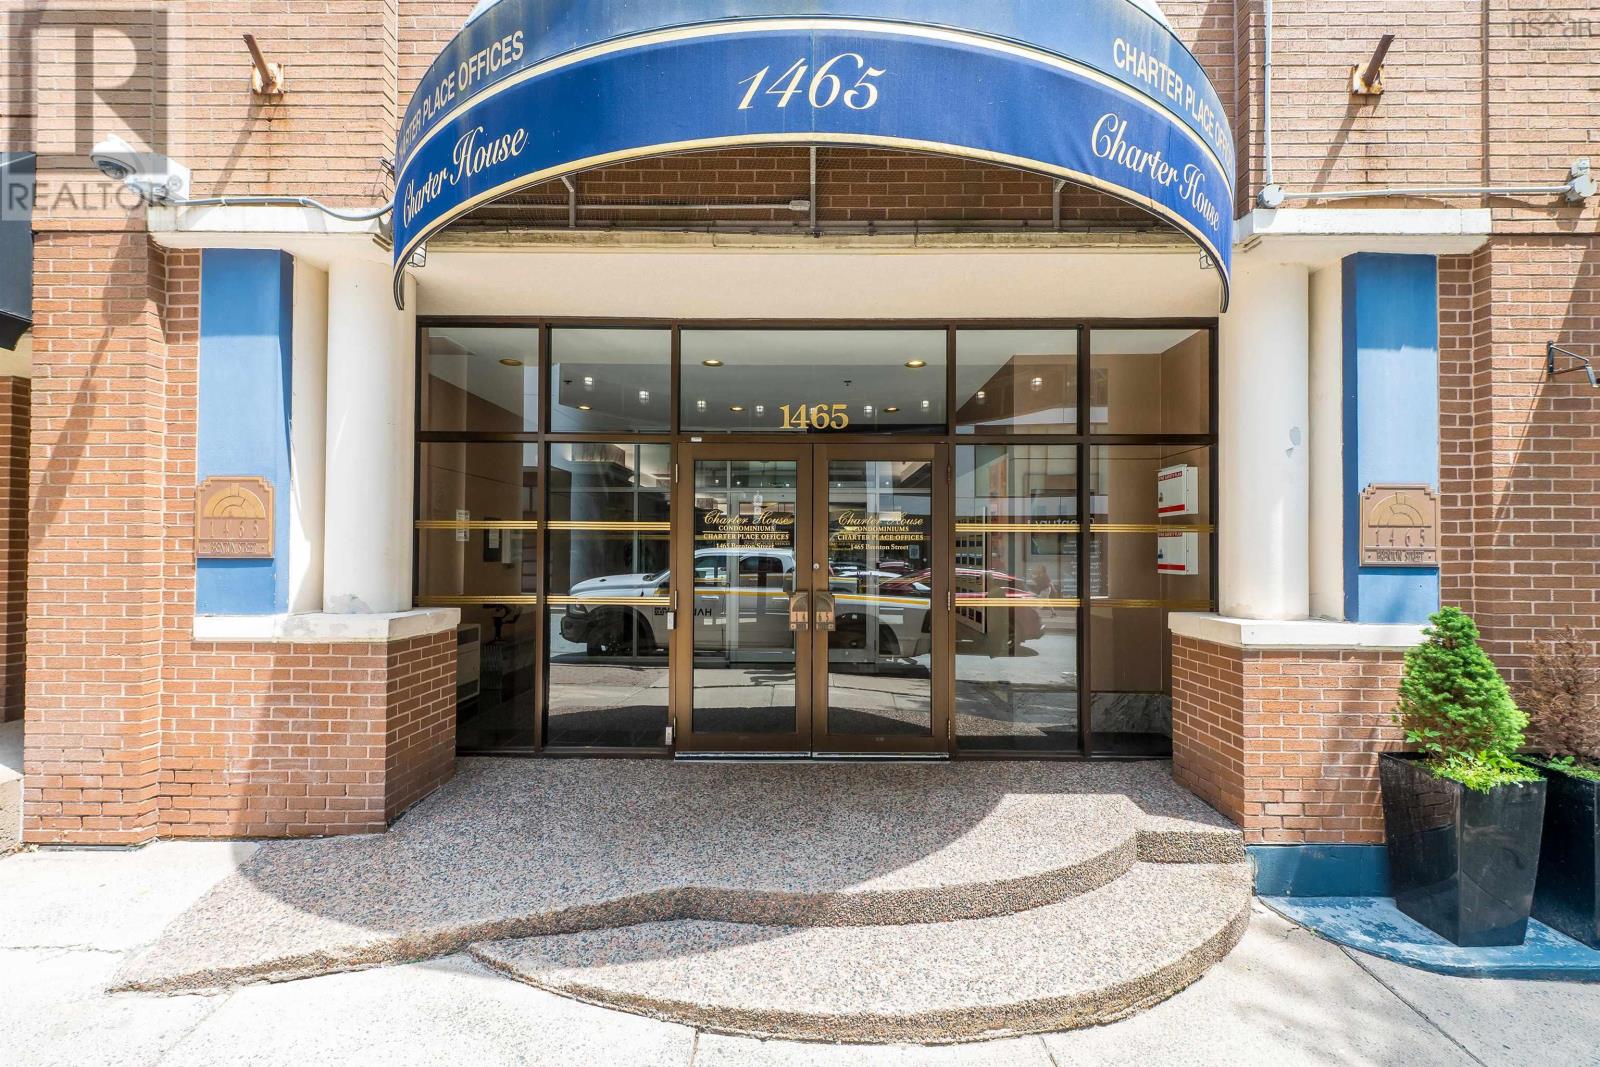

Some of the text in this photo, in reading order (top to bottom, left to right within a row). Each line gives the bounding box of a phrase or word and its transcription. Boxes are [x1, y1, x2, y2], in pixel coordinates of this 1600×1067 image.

[422, 69, 456, 126] PLACE
[458, 30, 524, 92] OFFICES
[737, 52, 887, 110] 1465
[1113, 37, 1184, 107] CHARTER
[1185, 83, 1214, 139] PLACE
[403, 125, 529, 228] Charter House
[1091, 112, 1219, 232] Charter House
[779, 403, 849, 429] 1465
[703, 508, 793, 525] Charter House
[838, 510, 881, 526] Charter
